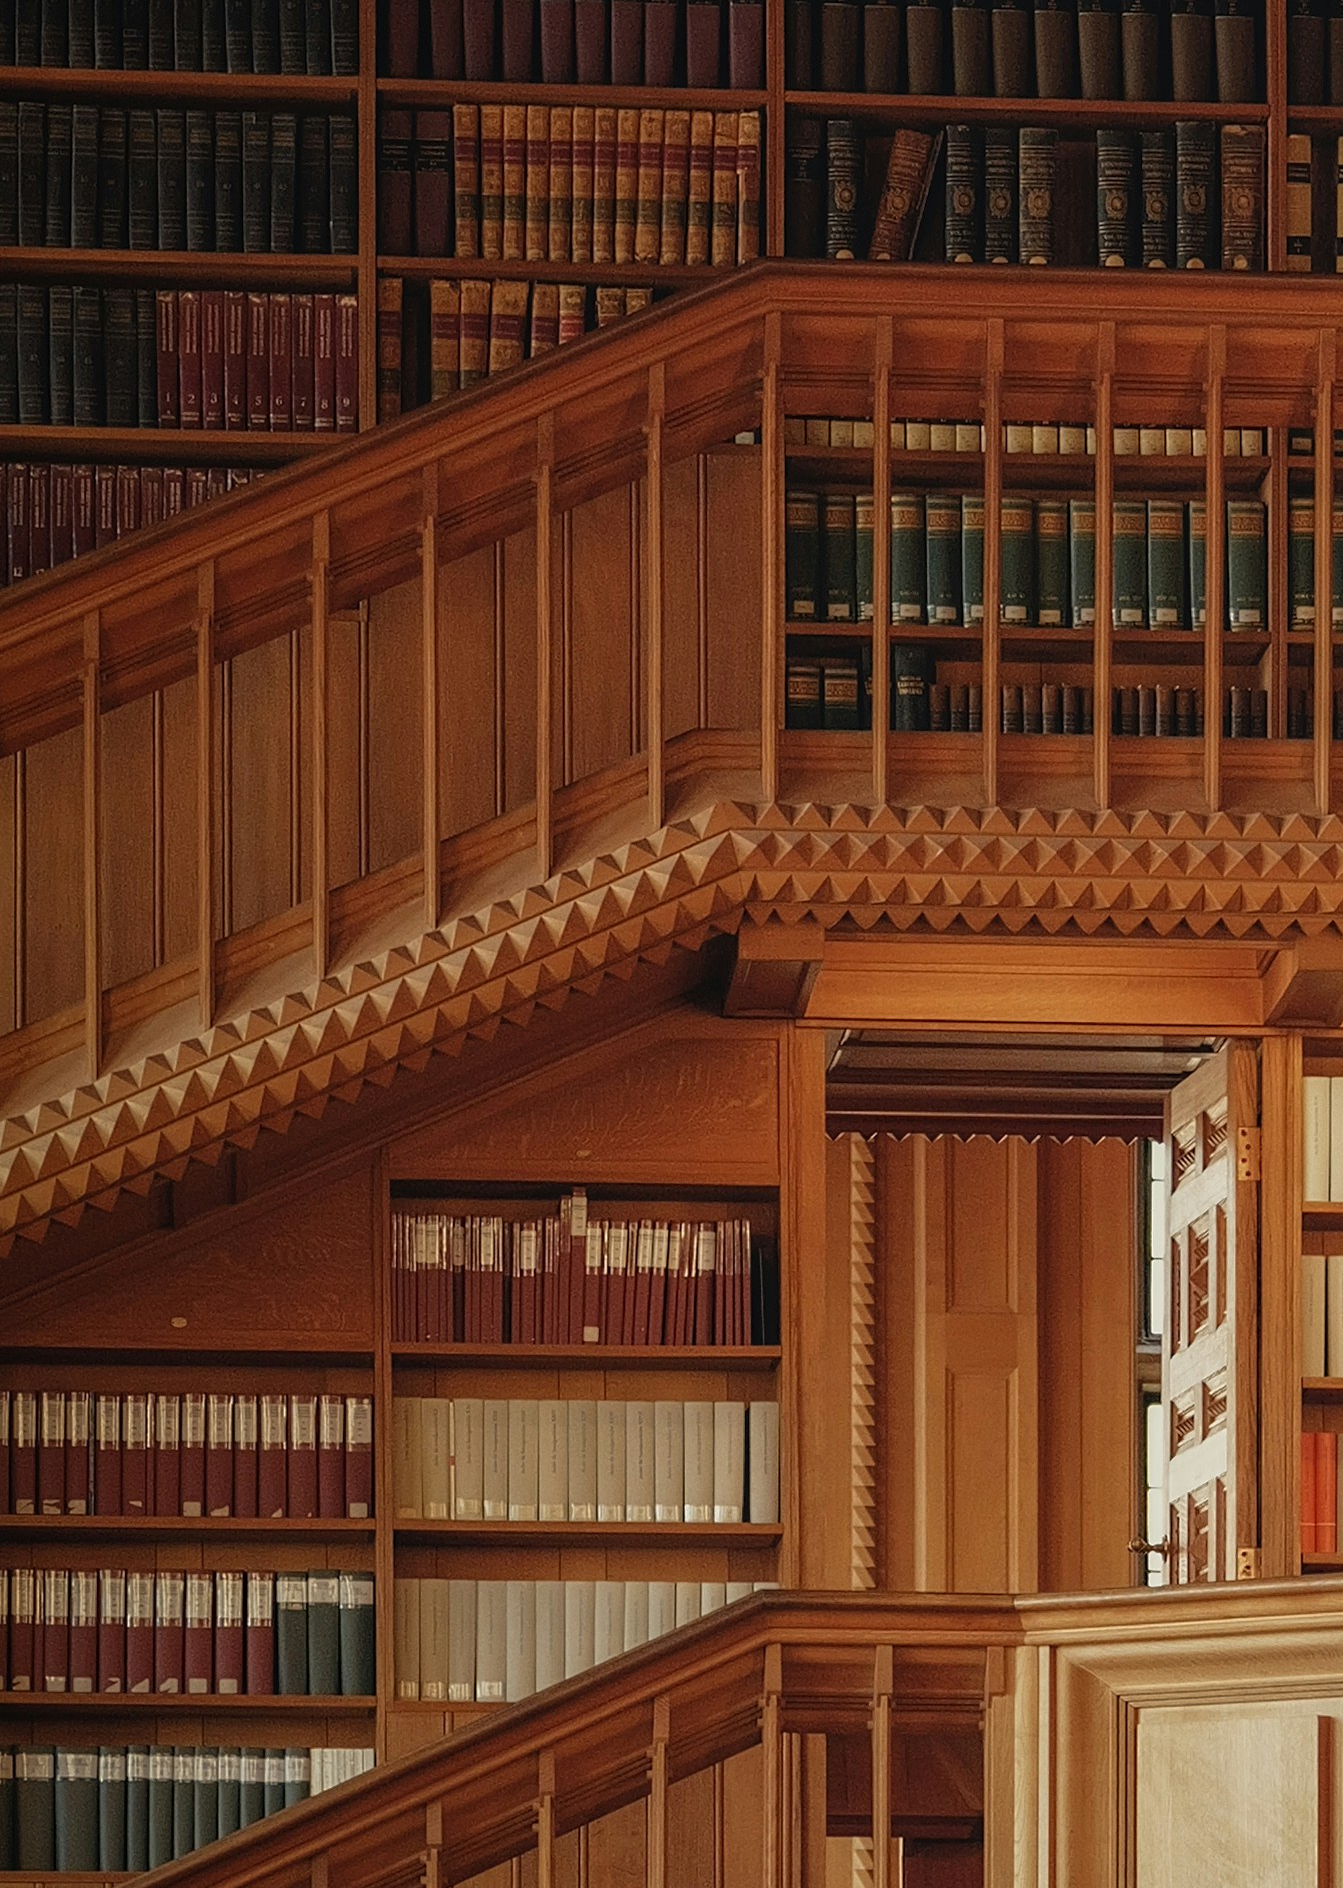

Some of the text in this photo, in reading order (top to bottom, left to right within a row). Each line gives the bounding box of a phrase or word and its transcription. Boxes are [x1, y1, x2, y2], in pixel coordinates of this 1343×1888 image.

[187, 395, 196, 404] 2
[210, 393, 218, 404] 3
[255, 395, 262, 406] 5
[275, 396, 283, 406] 6
[342, 397, 350, 408] 9
[321, 400, 328, 410] 8
